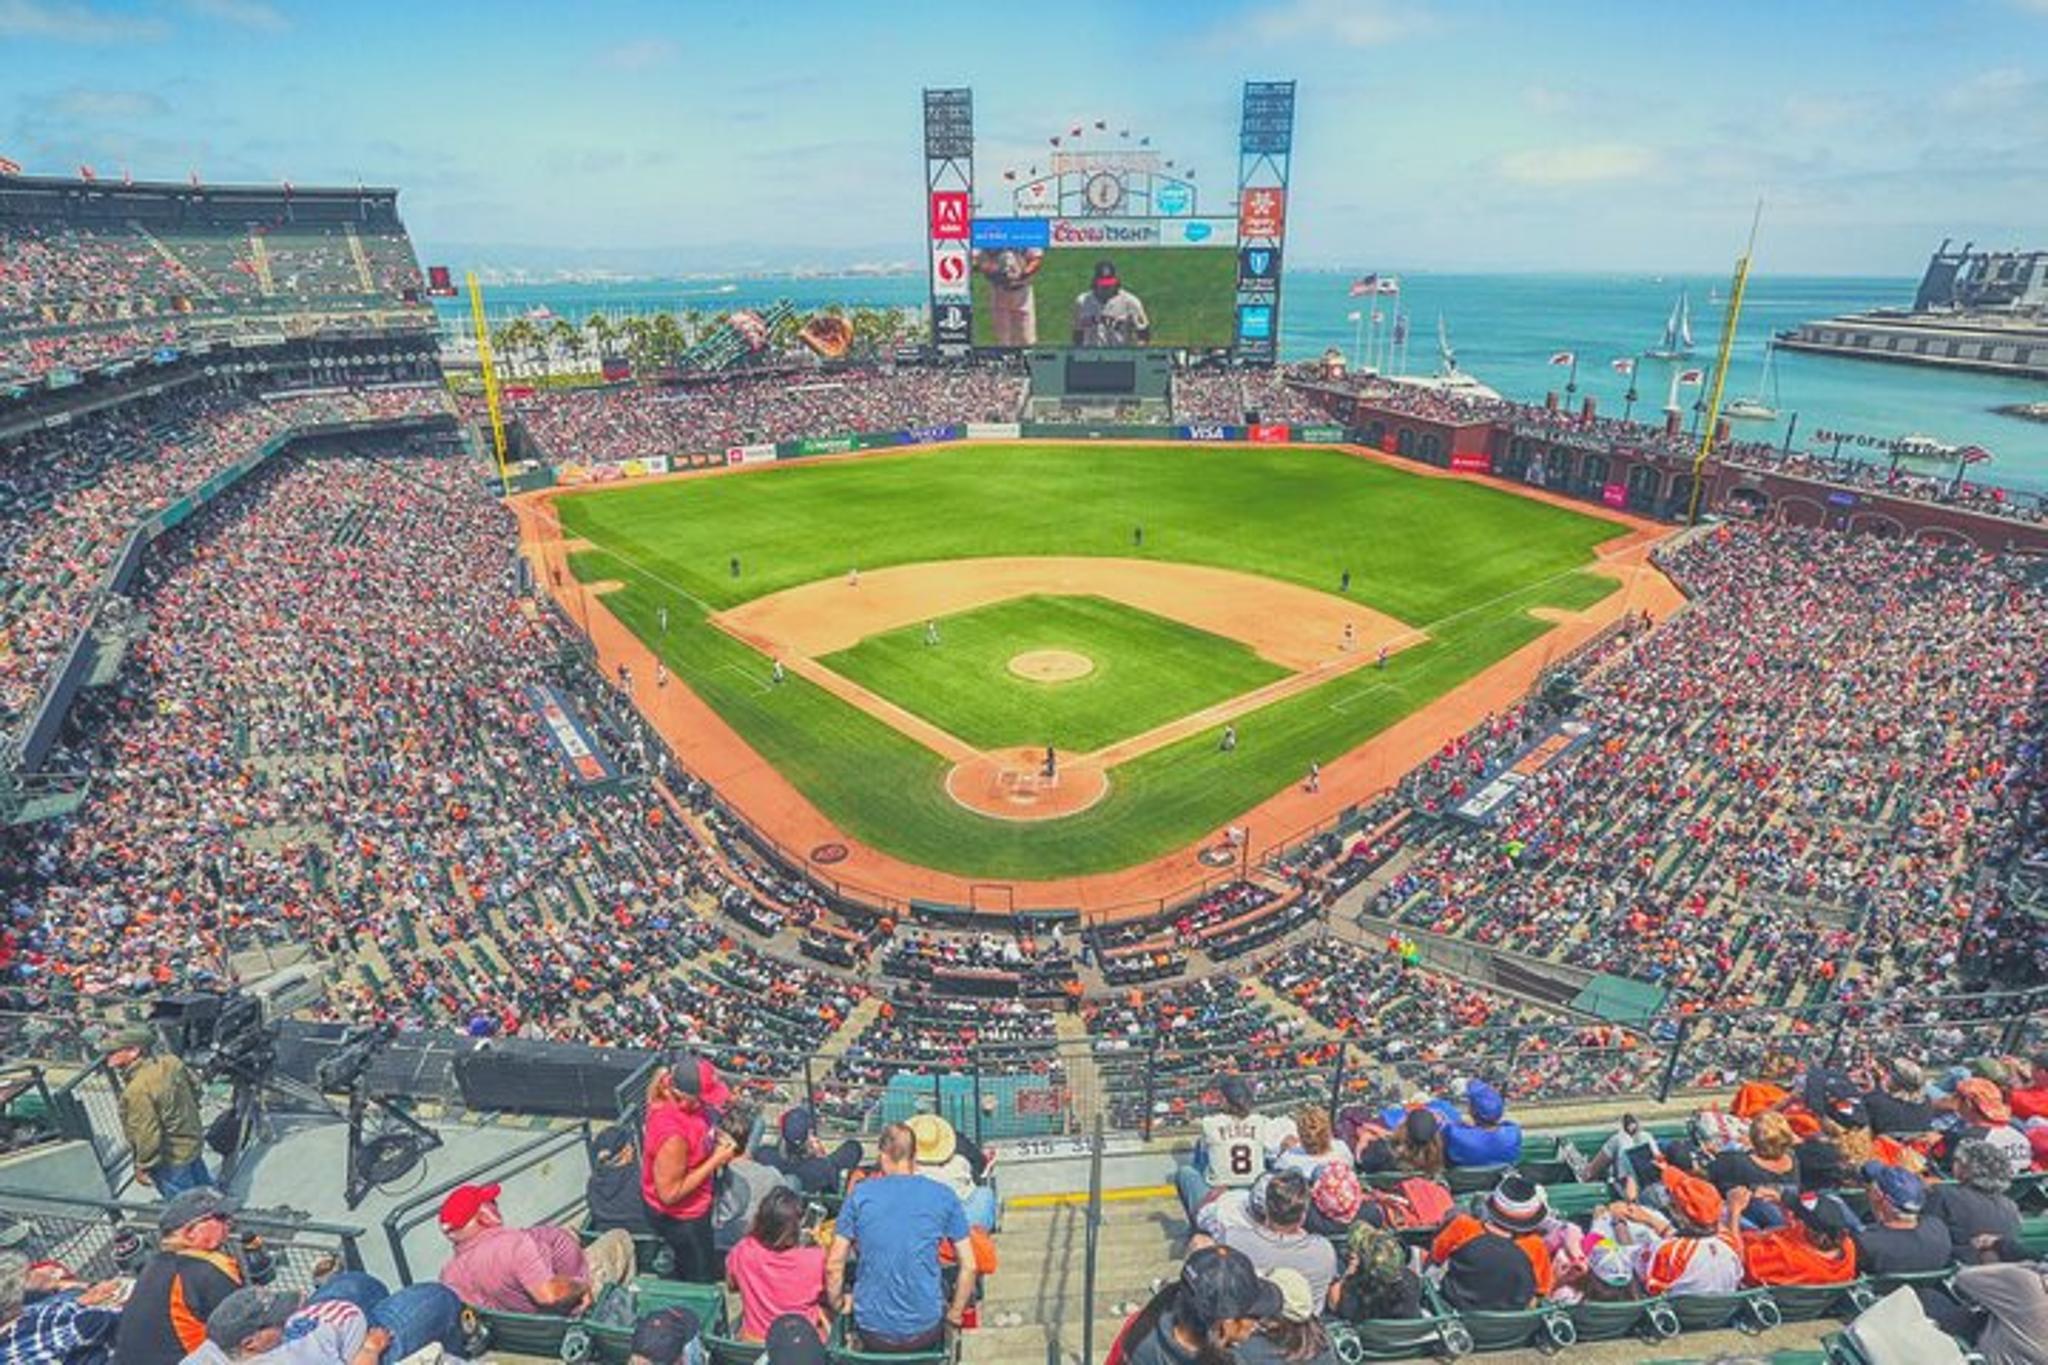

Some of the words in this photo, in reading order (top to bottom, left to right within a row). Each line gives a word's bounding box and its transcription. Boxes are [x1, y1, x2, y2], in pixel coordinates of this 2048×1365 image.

[1053, 220, 1103, 243] Coors
[1105, 223, 1151, 242] LIGHT
[1189, 425, 1224, 440] VISA
[1230, 1144, 1252, 1175] 8
